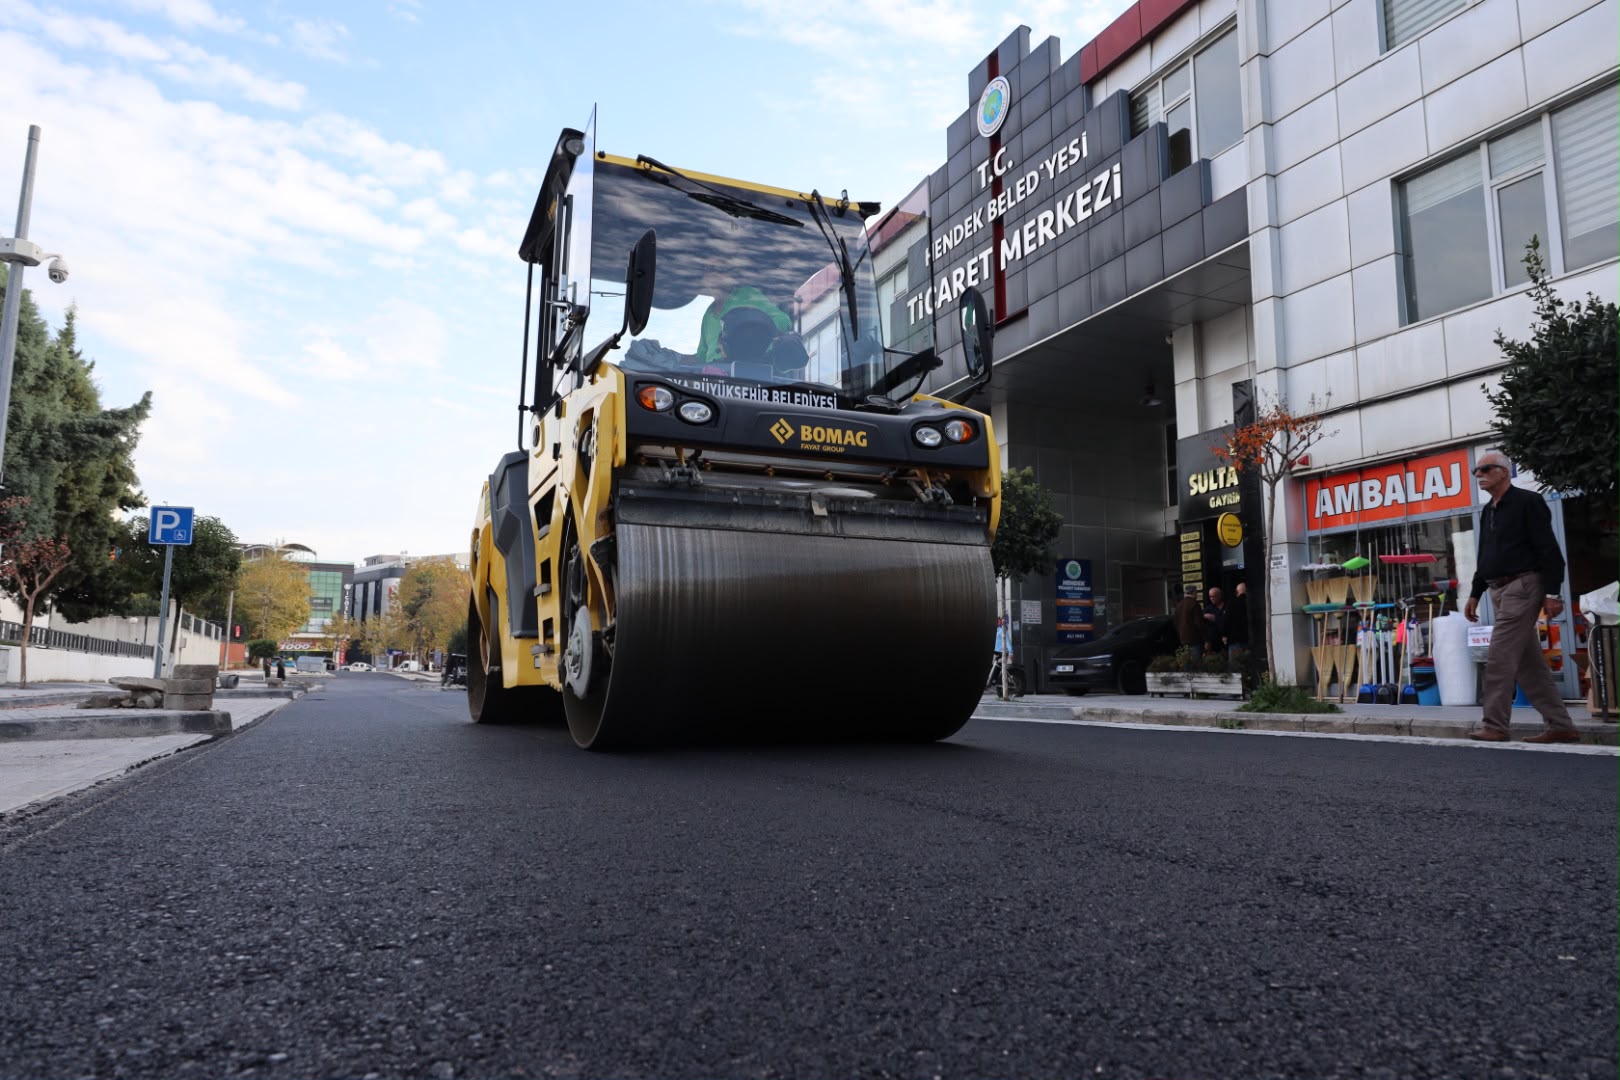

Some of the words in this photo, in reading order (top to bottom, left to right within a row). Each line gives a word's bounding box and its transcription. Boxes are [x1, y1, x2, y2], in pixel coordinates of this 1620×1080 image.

[976, 146, 1014, 189] T.C.
[987, 131, 1089, 224] BELEDYESİ
[907, 246, 993, 325] TİCARET
[1000, 162, 1122, 271] MERKEZİ
[772, 390, 837, 409] BELEDİYESİ
[800, 425, 868, 447] BOMAG
[800, 443, 821, 451] FAYAT
[822, 445, 845, 453] GROUP
[1314, 462, 1462, 519] AMBALAJ
[155, 510, 180, 540] P
